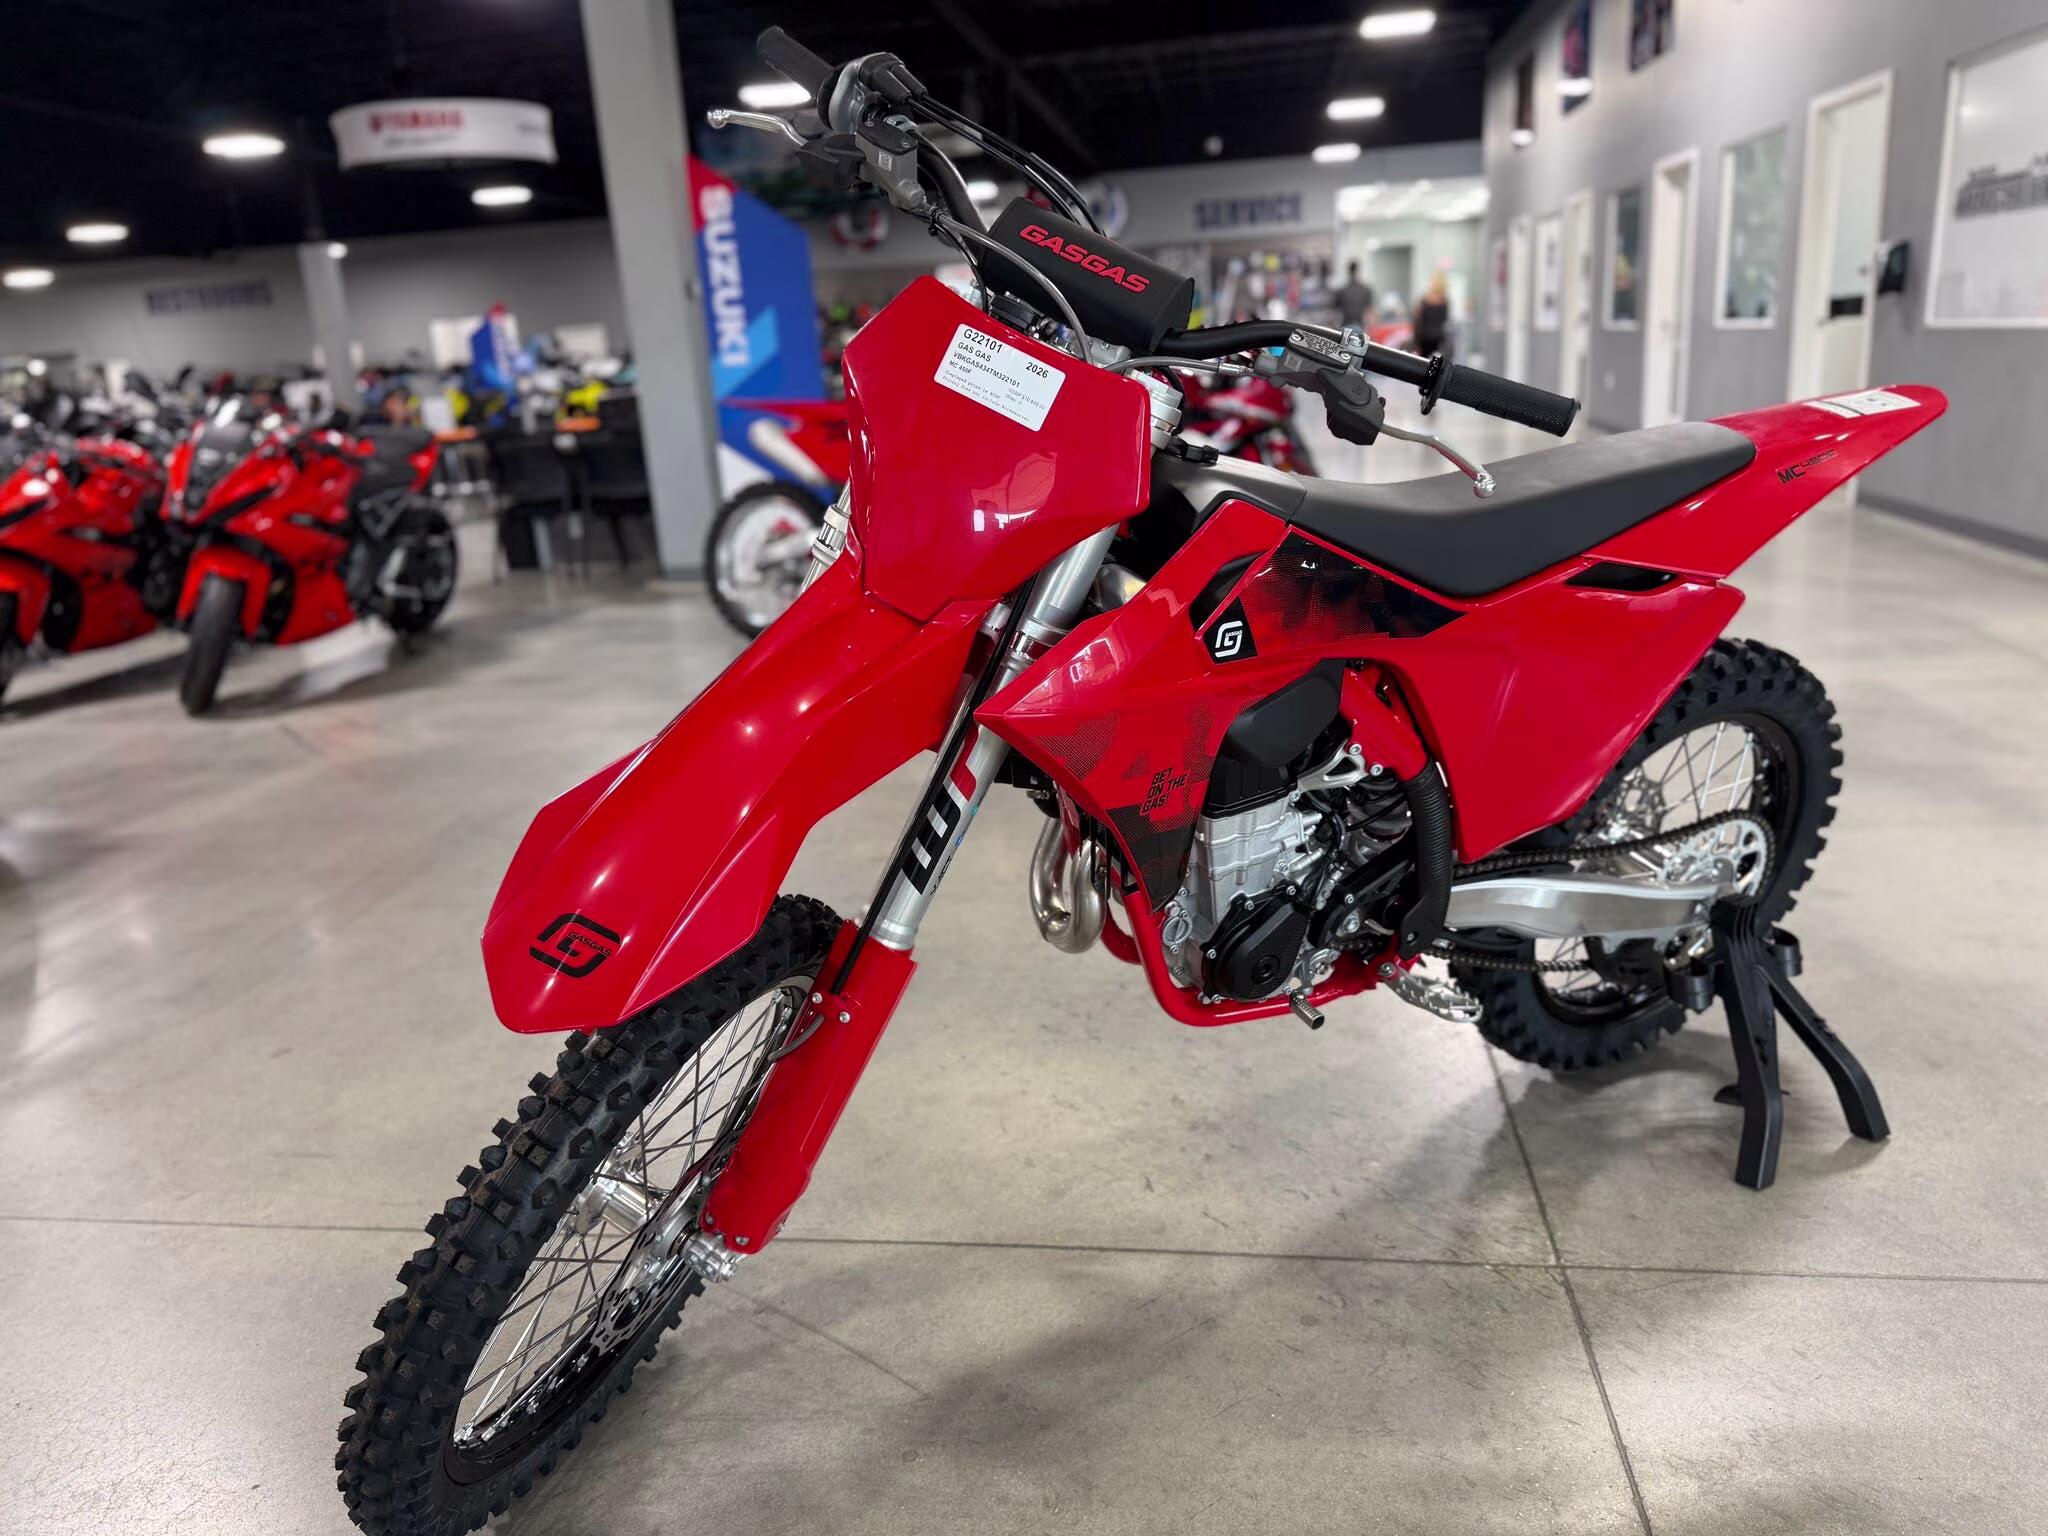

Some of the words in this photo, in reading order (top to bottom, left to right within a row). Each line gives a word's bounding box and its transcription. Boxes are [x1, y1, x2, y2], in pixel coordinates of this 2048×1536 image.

[1019, 224, 1150, 293] GASGAS
[700, 184, 750, 367] SUZUKI
[957, 341, 974, 354] GAS
[974, 349, 992, 362] GAS
[963, 328, 1003, 354] G22101
[949, 360, 959, 368] MC
[1025, 361, 1050, 379] 2026
[1148, 784, 1164, 799] ON
[1167, 773, 1189, 791] THE
[1152, 767, 1174, 785] GET
[1141, 793, 1170, 814] GAS!
[568, 931, 613, 958] GASGAS
